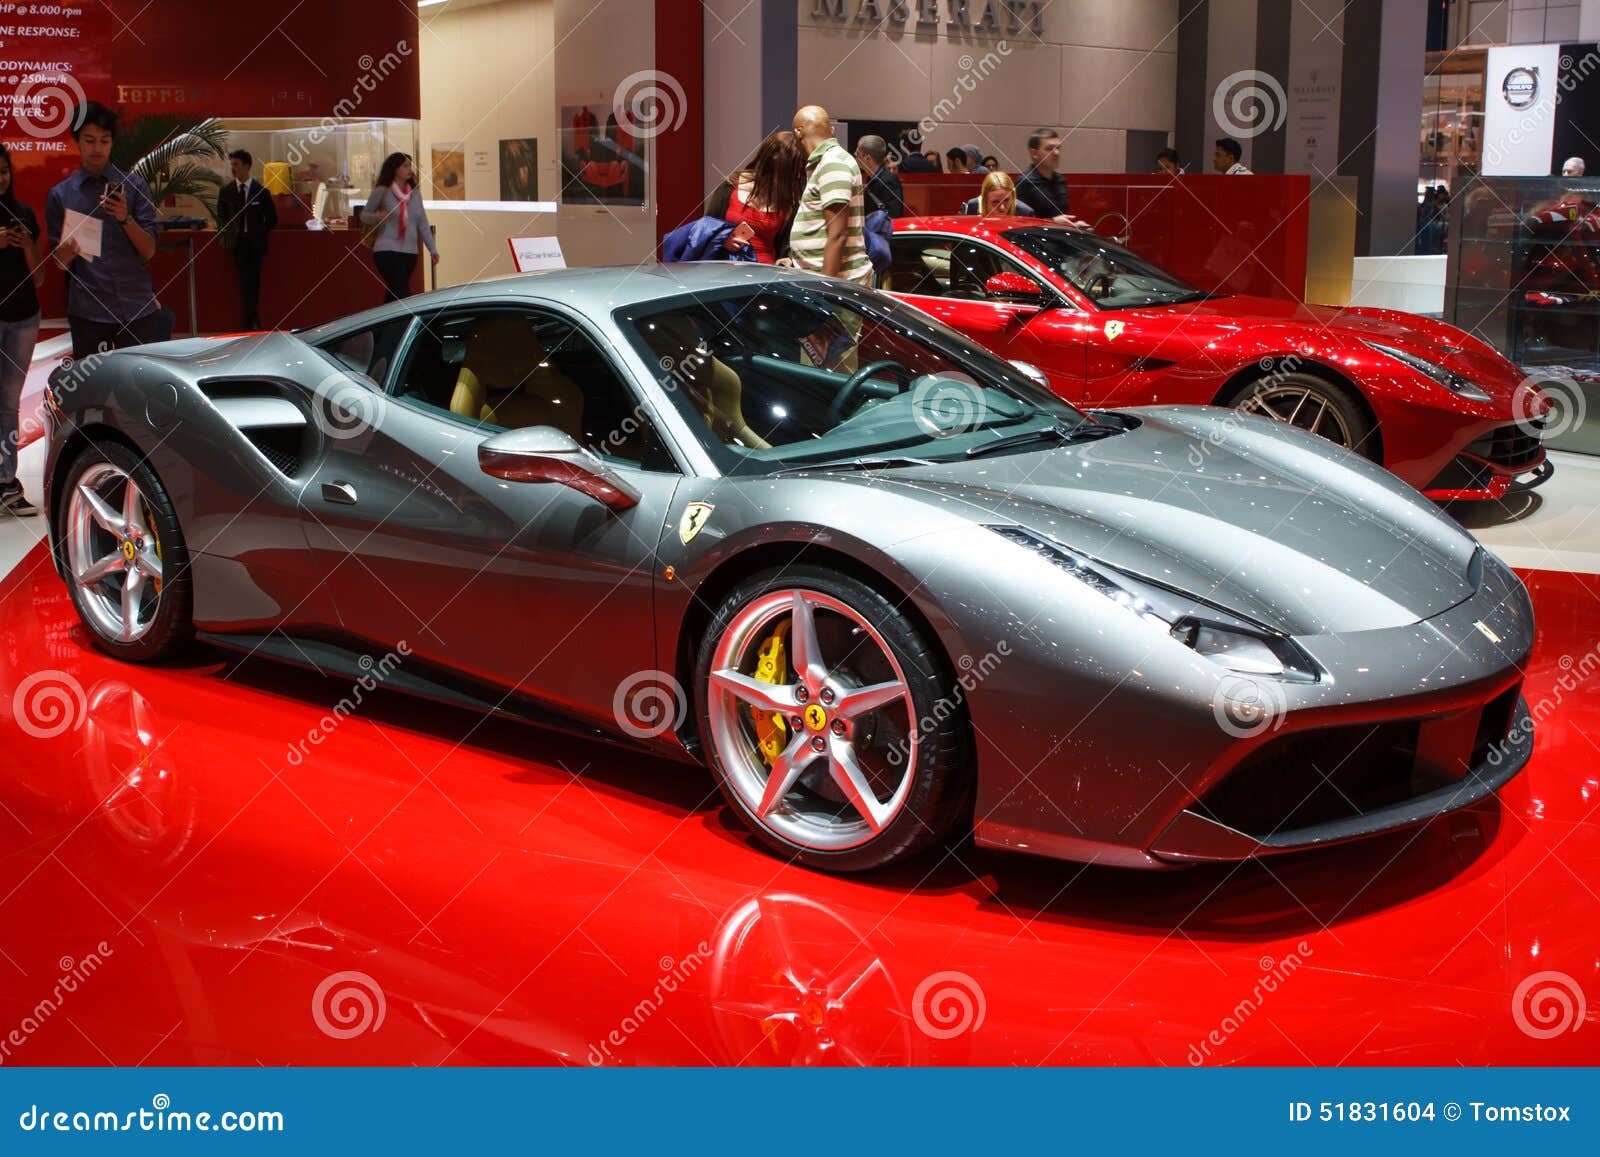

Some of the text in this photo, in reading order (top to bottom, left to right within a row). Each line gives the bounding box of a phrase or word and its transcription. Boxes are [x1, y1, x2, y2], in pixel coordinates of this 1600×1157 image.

[29, 4, 61, 15] 8.000
[62, 7, 82, 18] rpm
[17, 26, 80, 38] RESPONSE:
[0, 60, 73, 72] ODYNAMICS:
[12, 107, 45, 118] EVER:
[34, 141, 67, 153] TIME:
